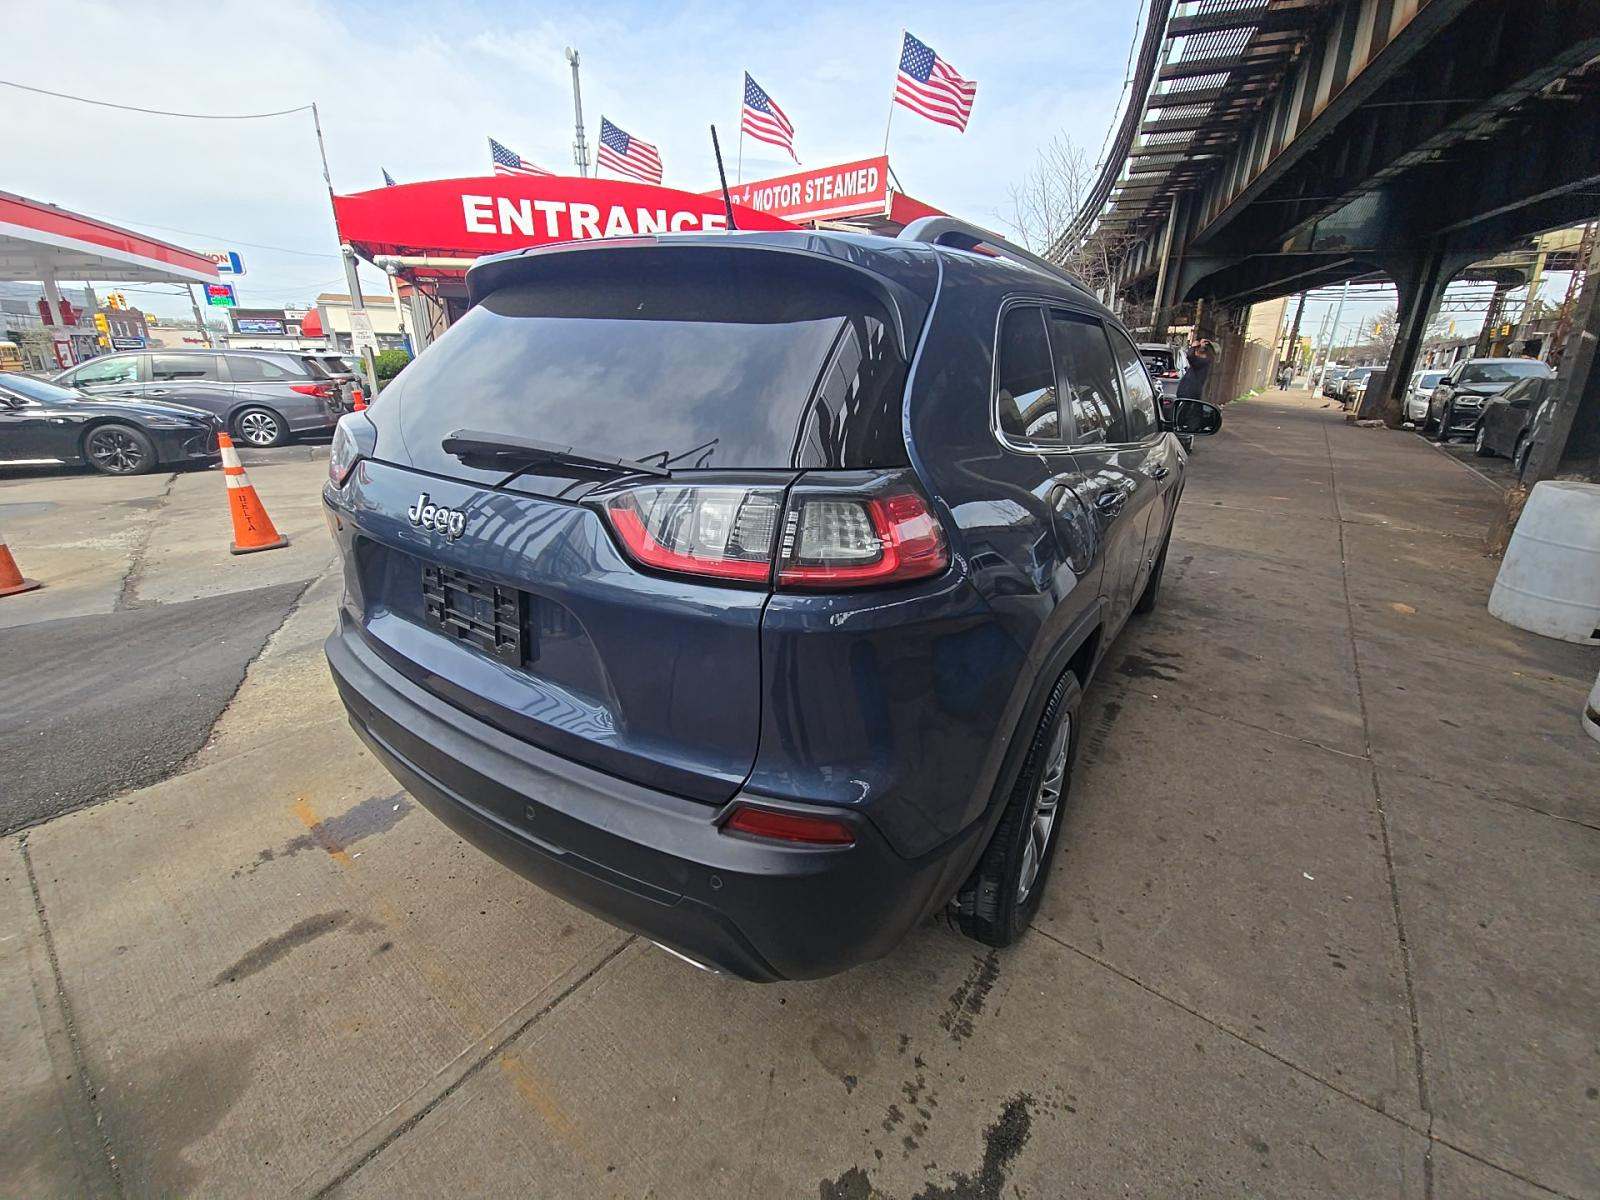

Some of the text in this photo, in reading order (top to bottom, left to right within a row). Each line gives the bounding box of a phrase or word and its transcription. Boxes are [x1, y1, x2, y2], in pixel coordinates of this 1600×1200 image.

[753, 167, 879, 212] MOTOR STEAMED
[239, 495, 256, 531] DELTA
[408, 492, 467, 545] Jeep
